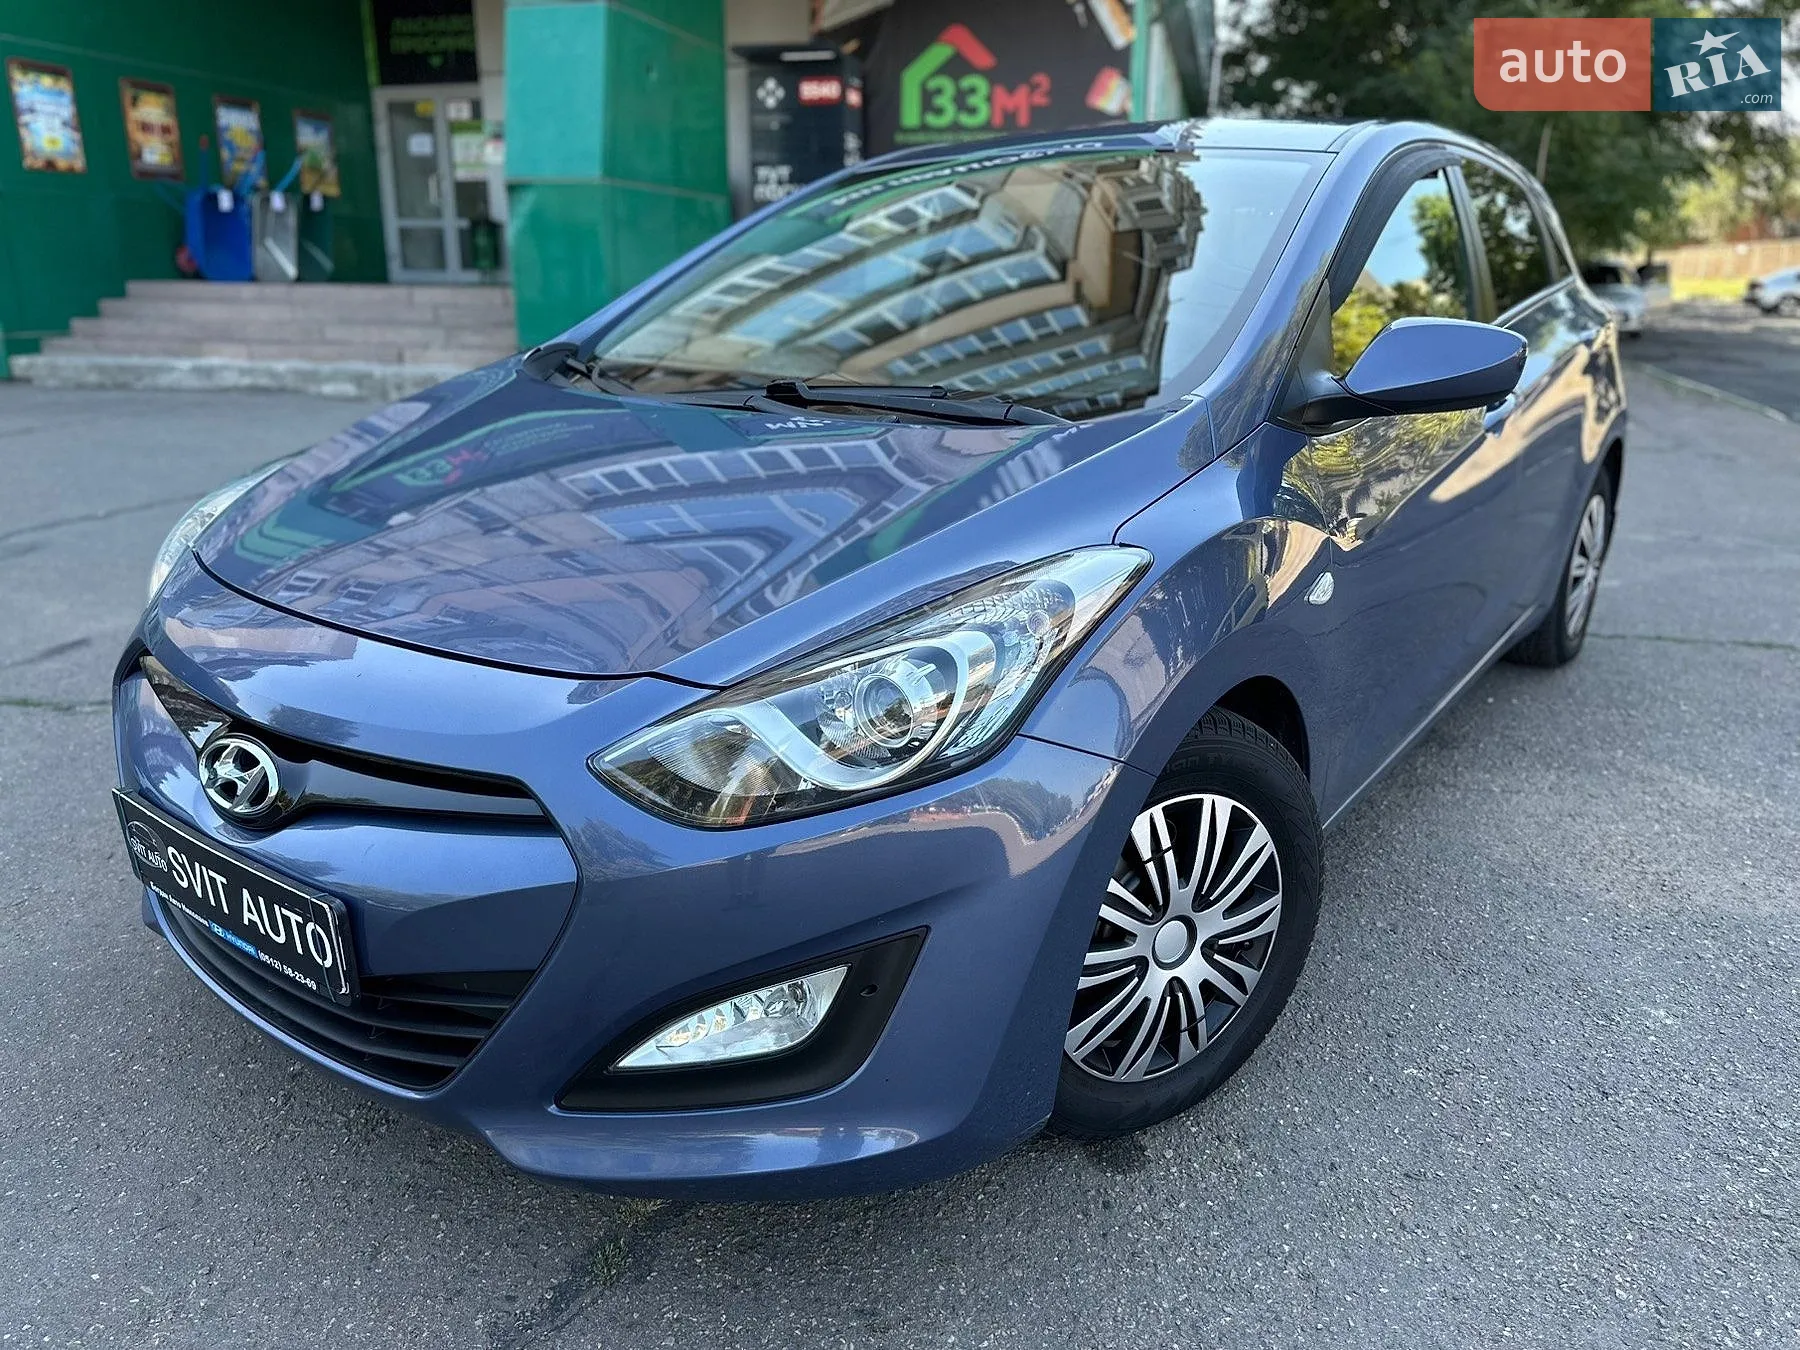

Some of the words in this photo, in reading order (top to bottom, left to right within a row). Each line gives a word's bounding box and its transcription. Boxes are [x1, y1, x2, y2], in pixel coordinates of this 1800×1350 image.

[130, 836, 147, 858] SVIT
[147, 850, 168, 873] AUTO
[167, 845, 230, 915] SVIT
[241, 887, 334, 969] AUTO
